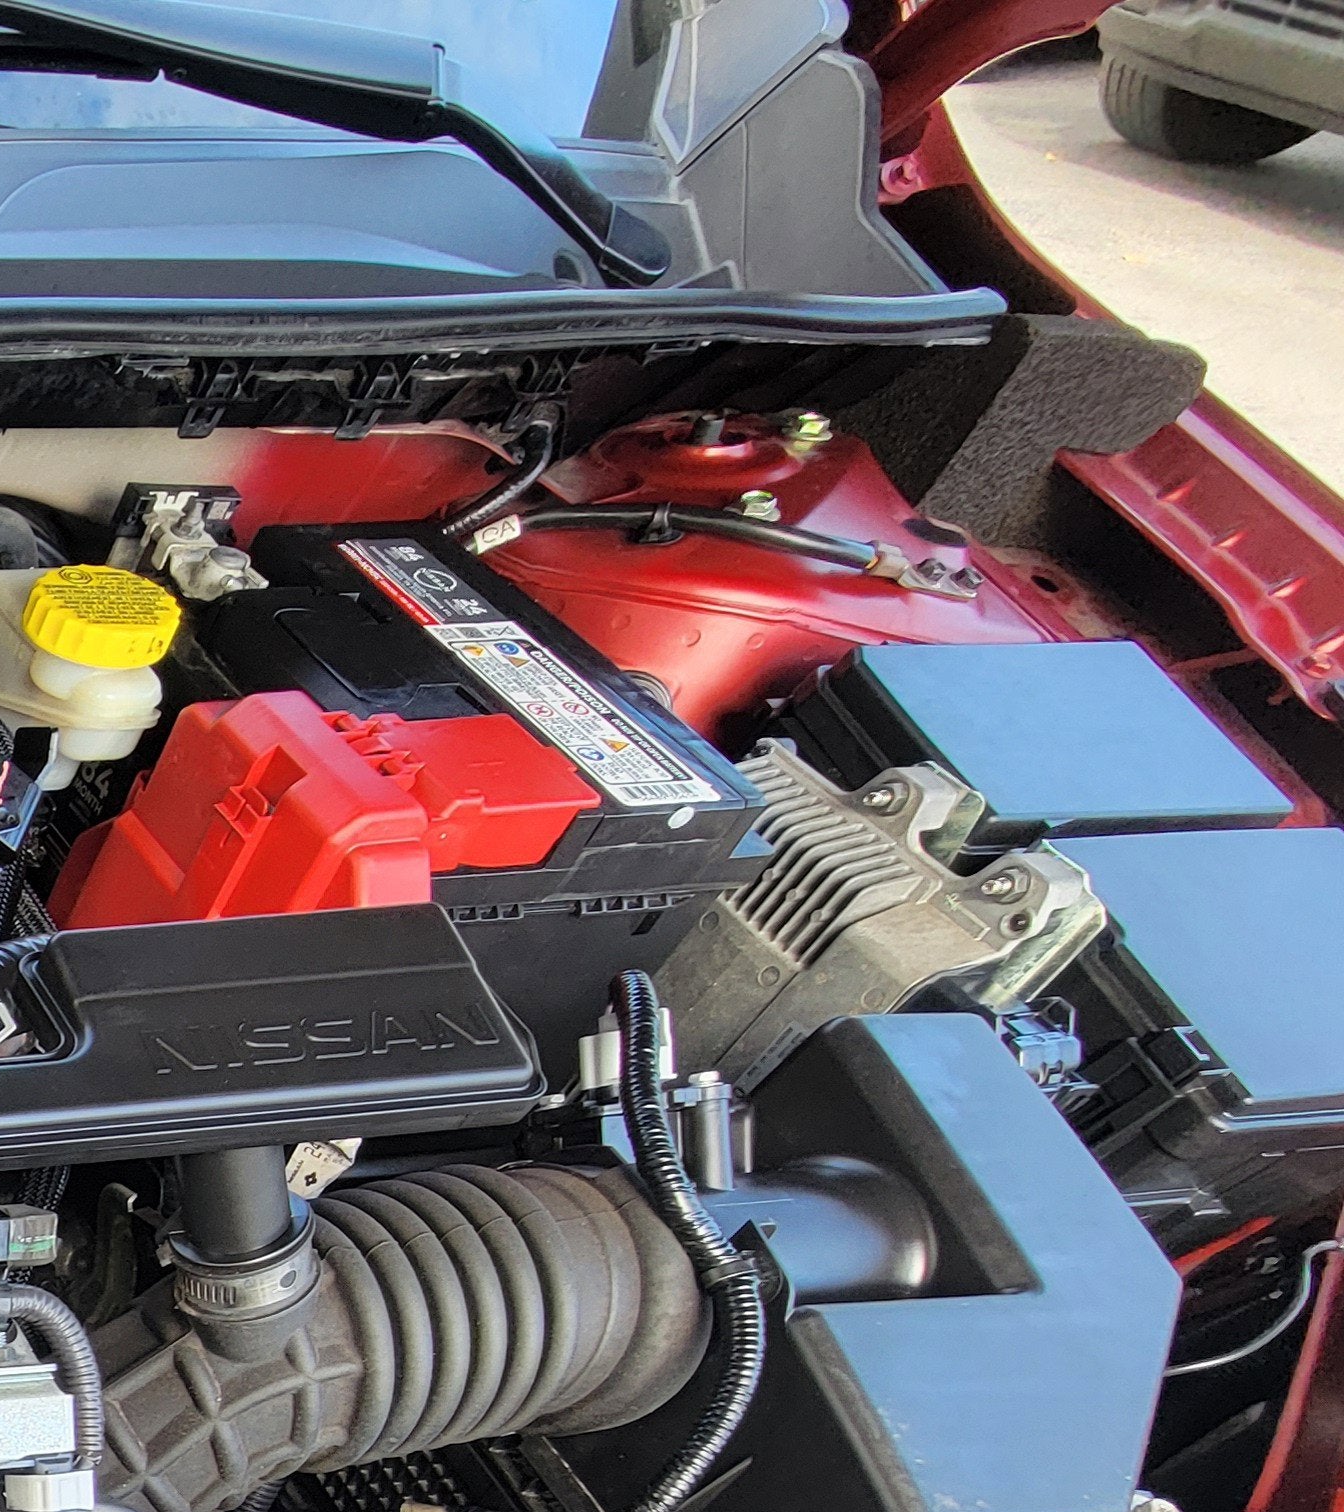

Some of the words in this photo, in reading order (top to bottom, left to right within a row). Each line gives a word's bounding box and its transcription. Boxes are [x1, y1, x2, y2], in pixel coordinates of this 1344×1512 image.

[481, 520, 515, 543] CA
[74, 777, 104, 816] MONTH
[142, 1001, 501, 1075] NISSAN
